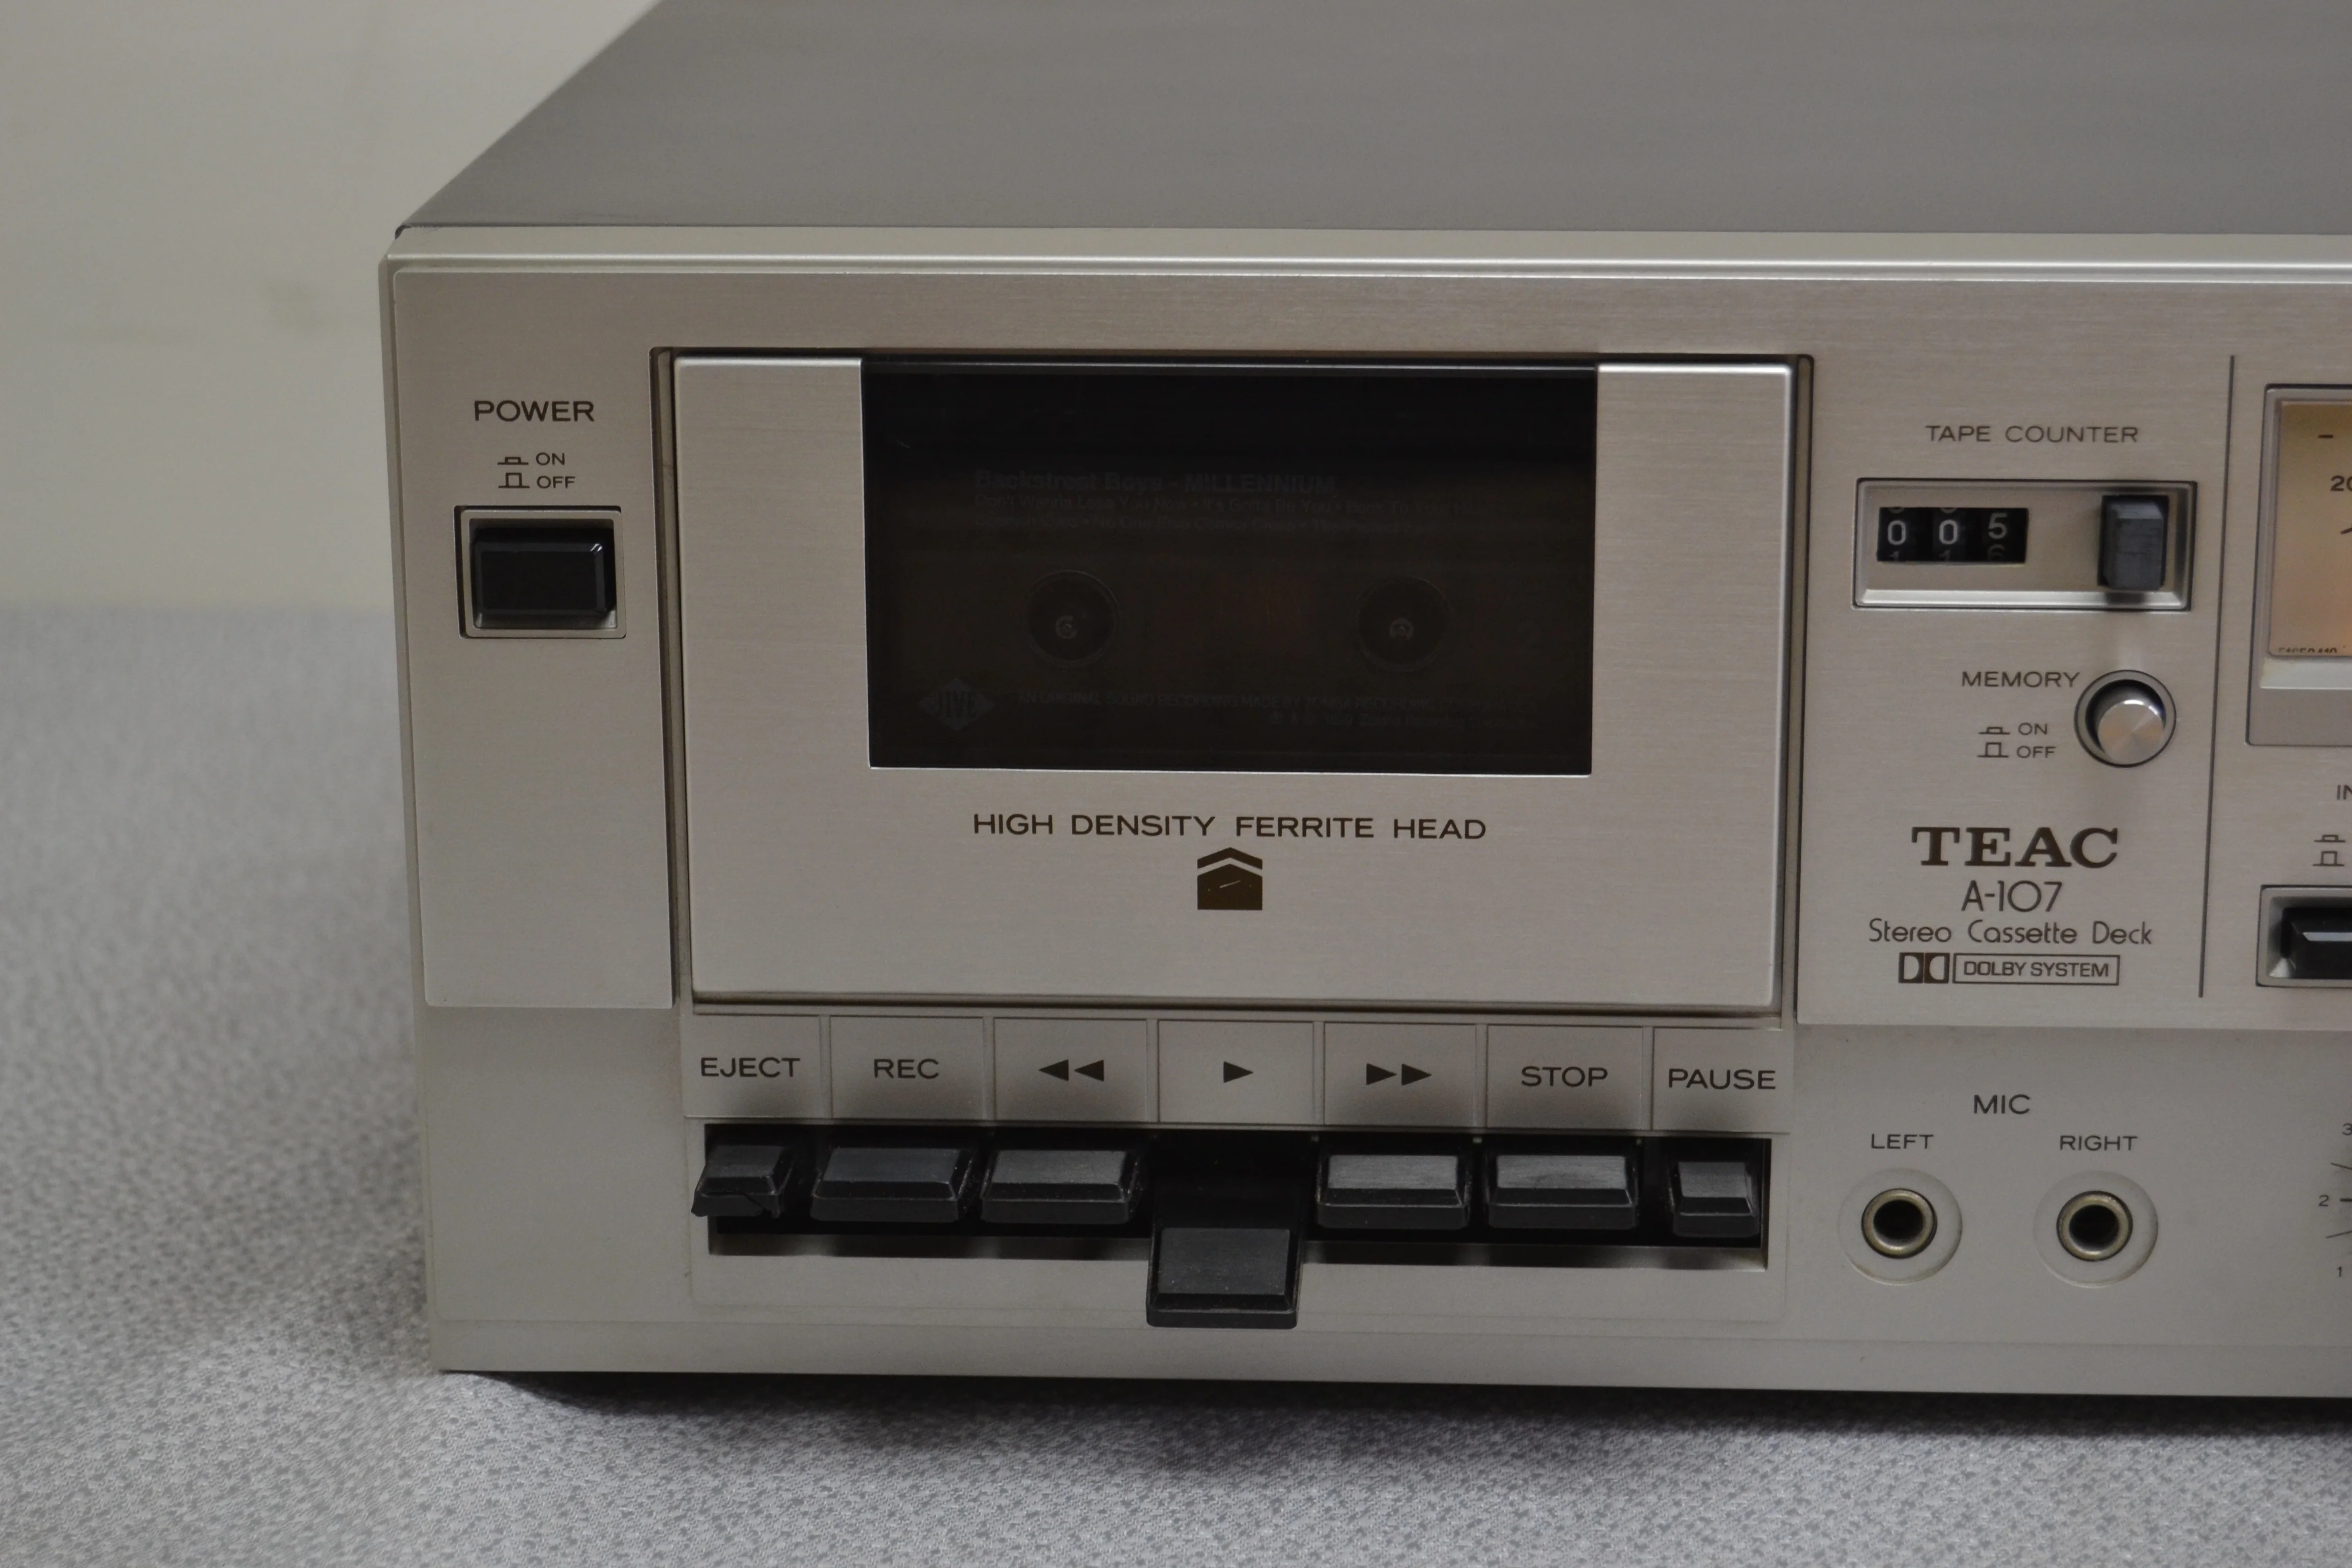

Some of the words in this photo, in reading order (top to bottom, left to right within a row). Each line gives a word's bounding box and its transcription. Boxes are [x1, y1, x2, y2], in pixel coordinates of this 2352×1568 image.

[473, 399, 595, 423] POWER
[1925, 425, 1991, 443] TAPE
[2004, 425, 2139, 444] COUNTER
[535, 451, 566, 467] ON
[536, 475, 576, 489] OFF
[1962, 670, 2080, 689] MEMORY
[2017, 722, 2048, 736] ON
[2016, 745, 2056, 759] OFF
[973, 813, 1054, 836] HIGH
[1071, 814, 1216, 837] DENSITY
[1235, 816, 1375, 839] FERRITE
[1393, 818, 1487, 840] HEAD
[1911, 826, 2119, 869] TEAC
[1961, 879, 2063, 913] A-107
[1869, 917, 1952, 943] Stereo
[1967, 918, 2078, 945] Cassette
[2092, 920, 2152, 945] Deck
[1963, 960, 2027, 977] DOLBY
[2030, 961, 2110, 978] SYSTEM
[700, 1056, 801, 1079] EJECT
[873, 1058, 940, 1080] REC
[1521, 1065, 1609, 1088] STOP
[1668, 1067, 1776, 1091] PAUSE
[1973, 1093, 2031, 1115] MIC
[1870, 1133, 1934, 1150] LEFT
[2059, 1134, 2138, 1152] RIGHT
[2318, 1193, 2330, 1208] 2
[2337, 1265, 2343, 1278] 1
